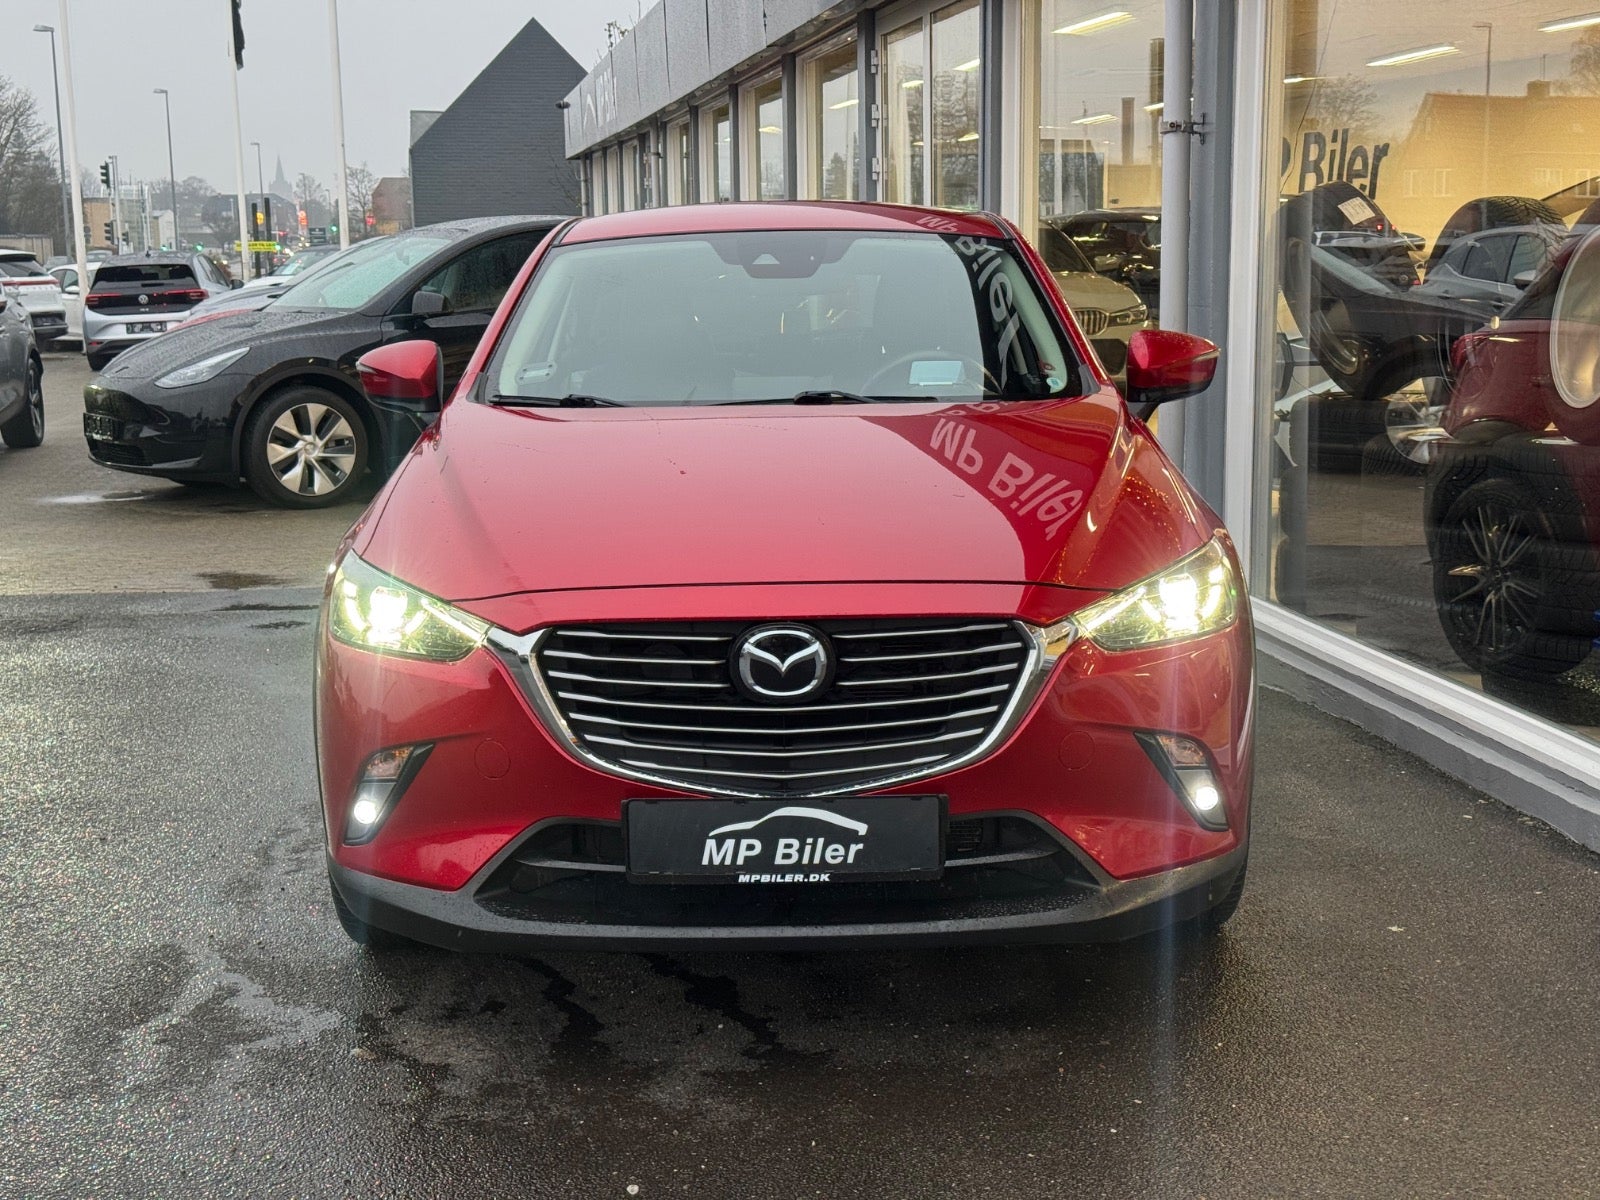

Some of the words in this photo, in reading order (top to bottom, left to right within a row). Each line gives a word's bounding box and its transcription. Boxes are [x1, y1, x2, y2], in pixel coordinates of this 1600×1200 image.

[1298, 127, 1390, 201] Biler
[701, 838, 762, 866] MP
[774, 837, 864, 865] Biler
[738, 873, 831, 883] MPBILER.DK
